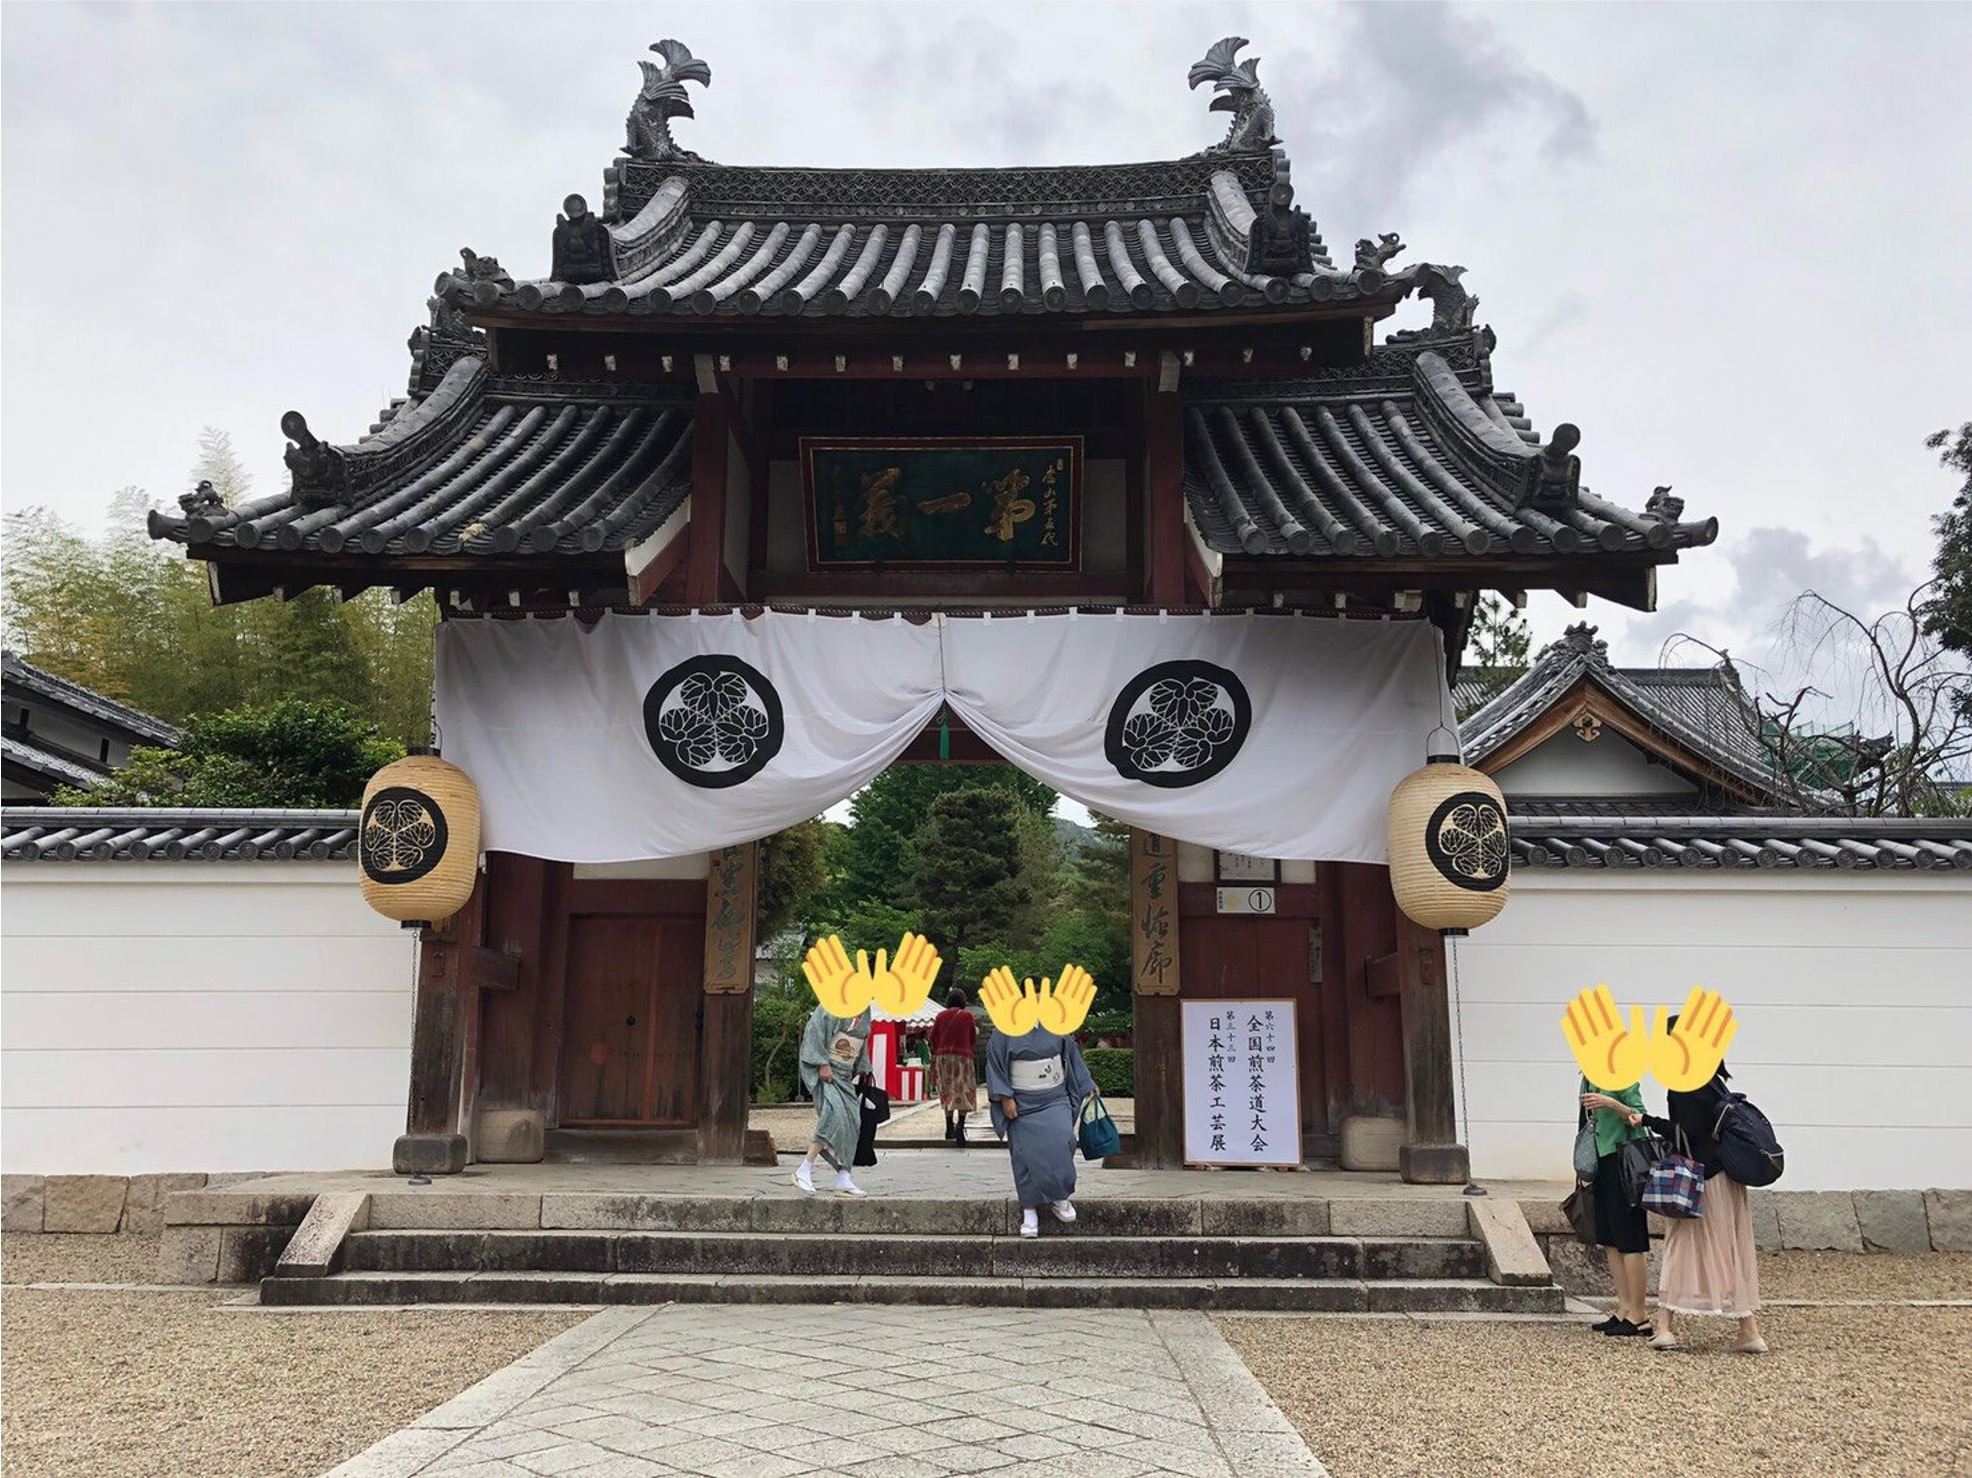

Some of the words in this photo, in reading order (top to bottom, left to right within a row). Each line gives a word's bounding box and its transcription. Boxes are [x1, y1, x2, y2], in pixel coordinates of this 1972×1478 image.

[1207, 1016, 1227, 1152] 日本煎茶工芸展
[1246, 1014, 1269, 1153] 全国煎茶道大会
[1264, 1010, 1277, 1064] 第六十四回
